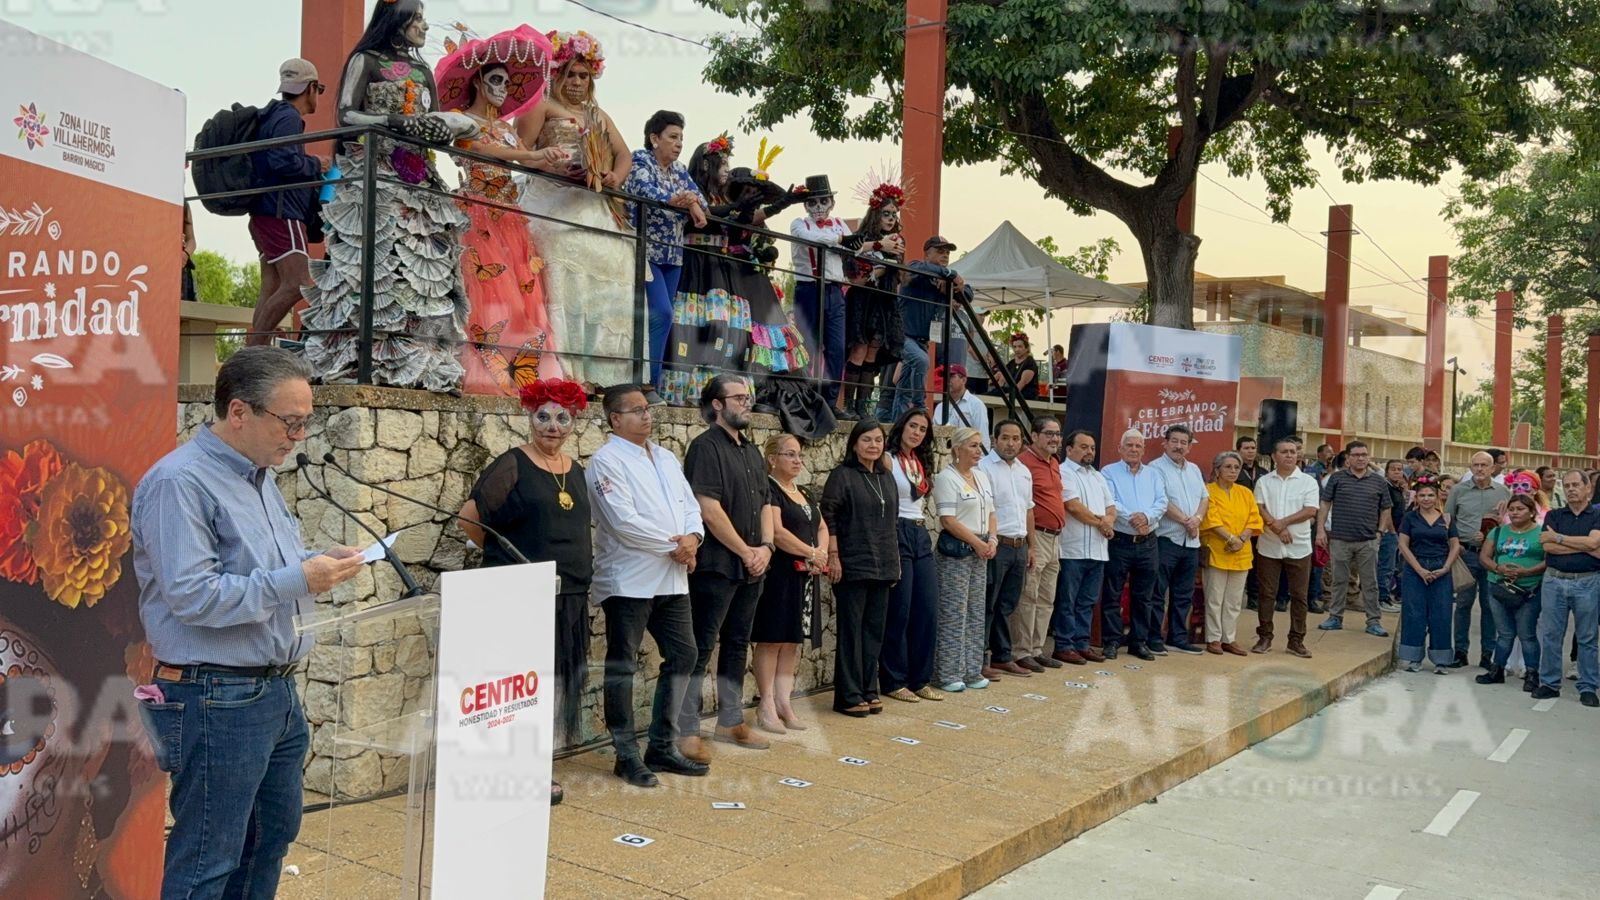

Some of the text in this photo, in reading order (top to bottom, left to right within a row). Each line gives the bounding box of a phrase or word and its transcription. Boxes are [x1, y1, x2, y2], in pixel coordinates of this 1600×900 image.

[53, 126, 116, 158] VILLAHERMOSA
[59, 111, 111, 142] ZONA LUZ DE
[1138, 402, 1217, 419] CELEBRANDO
[1127, 414, 1224, 439] La Eteidad
[460, 670, 539, 715] CENTRO
[459, 709, 498, 728] HONESTIDAD
[503, 697, 538, 714] RESULTADOS
[487, 714, 516, 729] 2024-2027
